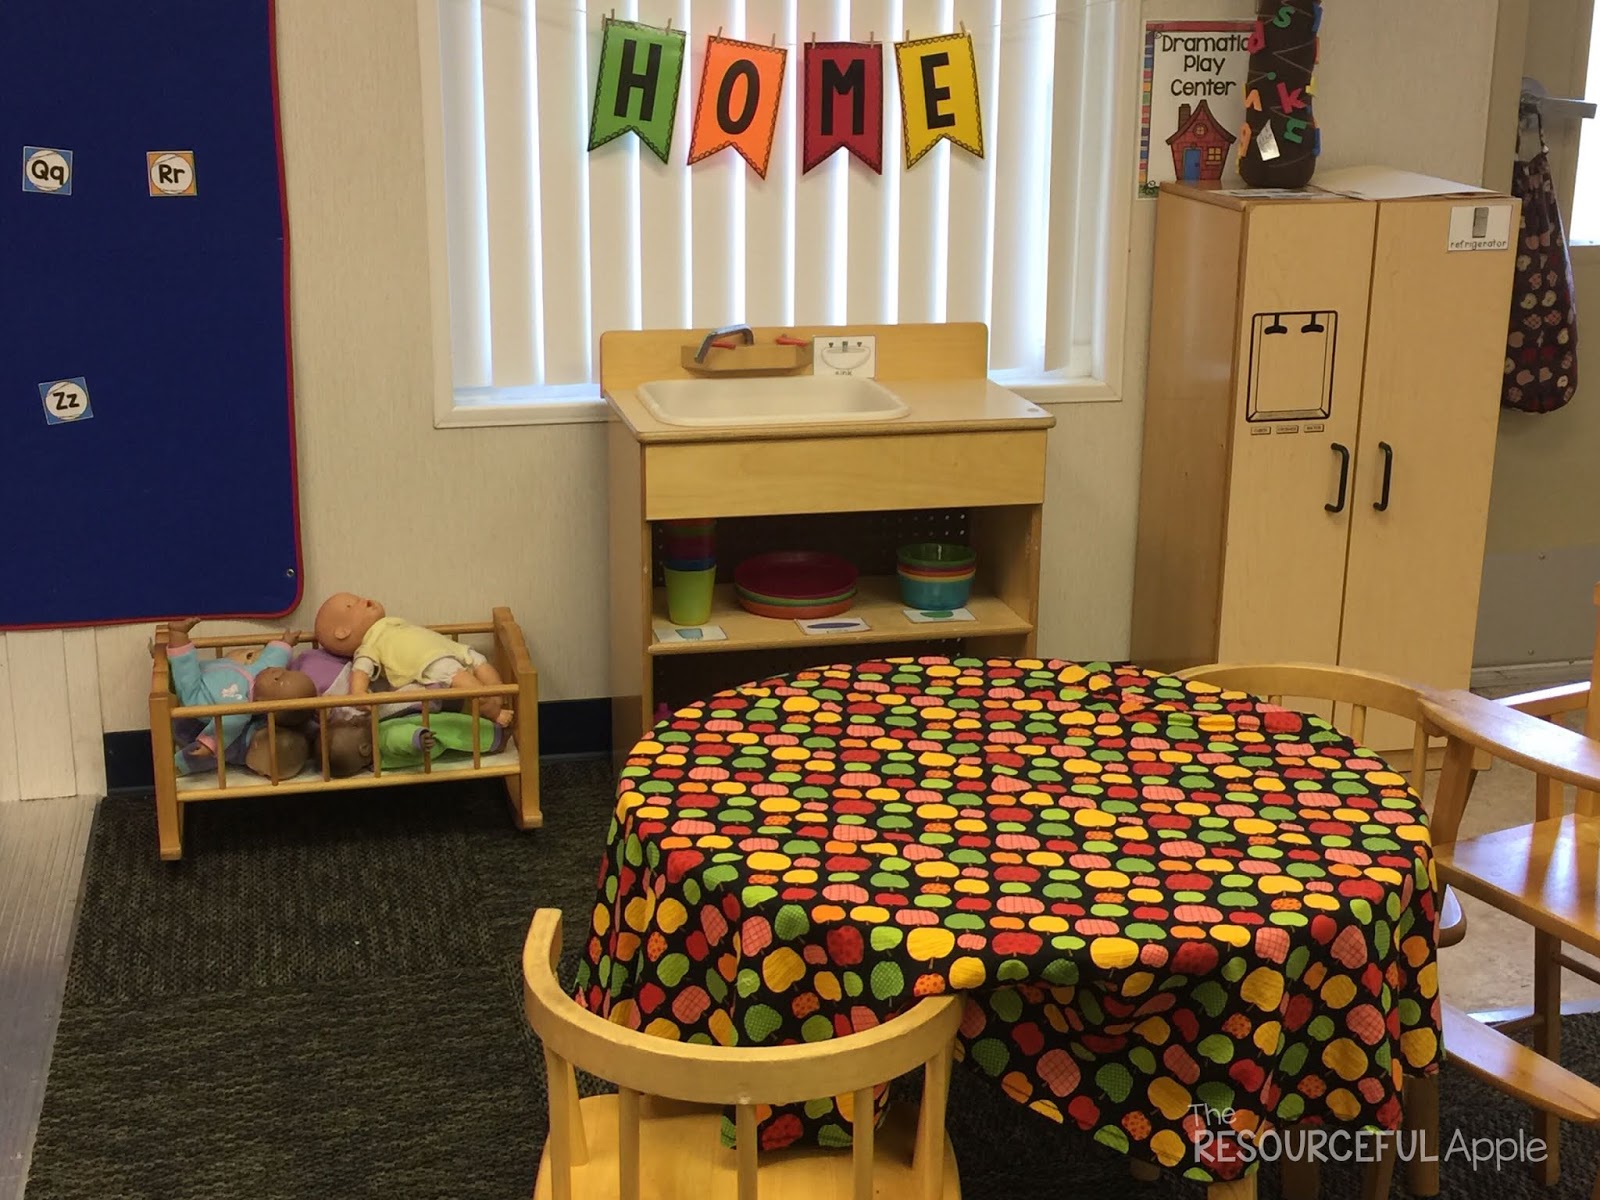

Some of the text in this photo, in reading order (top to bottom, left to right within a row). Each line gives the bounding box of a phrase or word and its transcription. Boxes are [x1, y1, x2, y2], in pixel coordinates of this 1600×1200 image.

[1183, 55, 1226, 75] Play
[614, 39, 955, 136] HOME
[1170, 78, 1237, 97] Center
[31, 159, 64, 186] Qq
[158, 164, 185, 184] Rr
[1450, 240, 1507, 251] refrigerator
[53, 391, 80, 411] Zz
